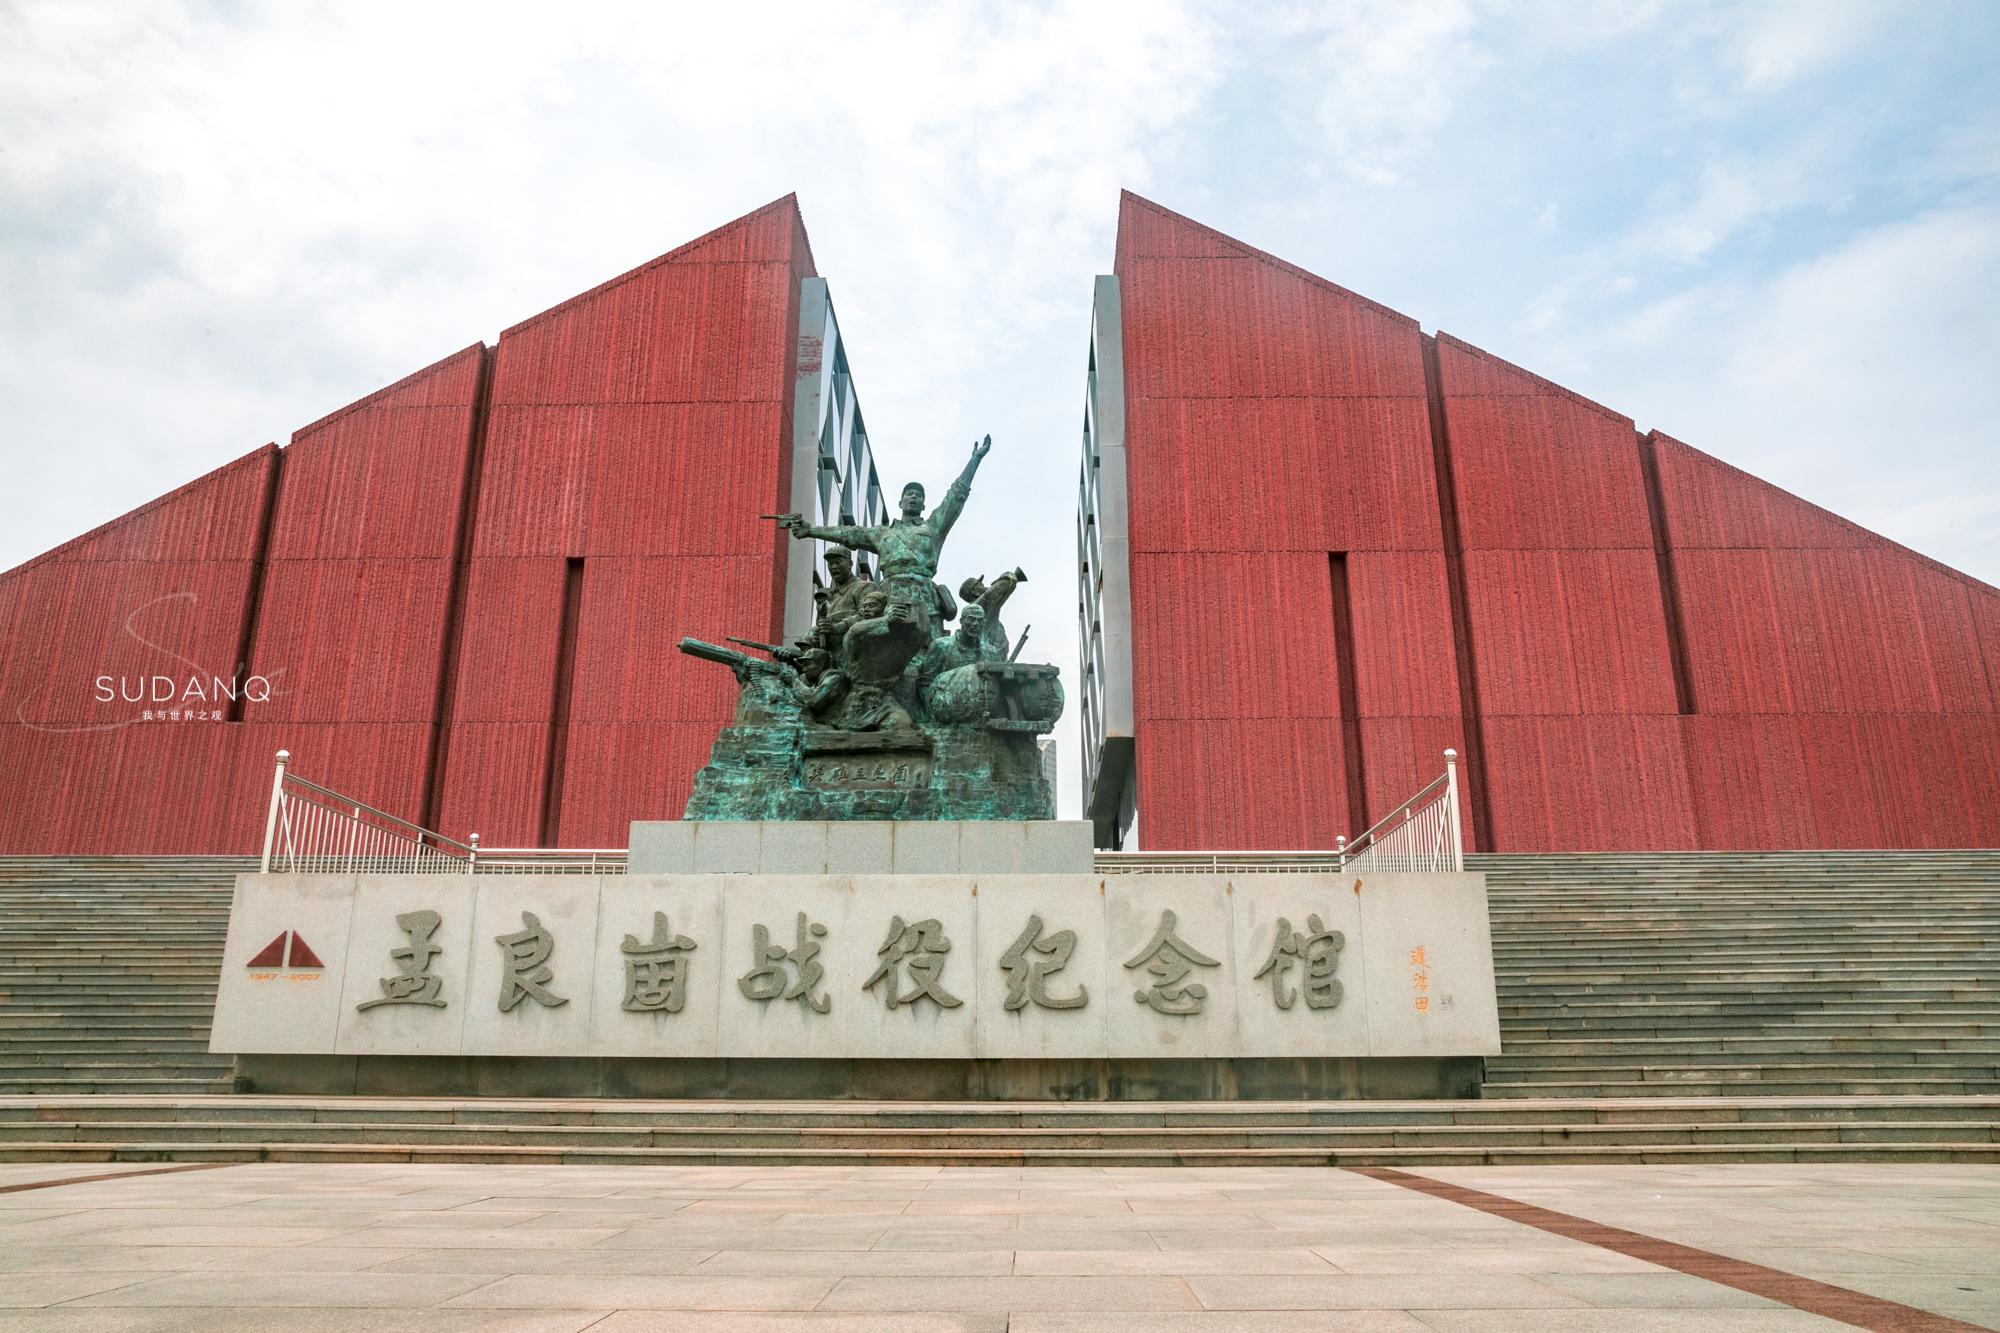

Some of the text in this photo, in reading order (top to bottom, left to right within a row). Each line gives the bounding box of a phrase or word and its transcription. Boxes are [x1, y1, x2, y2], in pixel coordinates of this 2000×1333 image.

[355, 909, 1346, 1016] 孟良崮战役纪念馆
